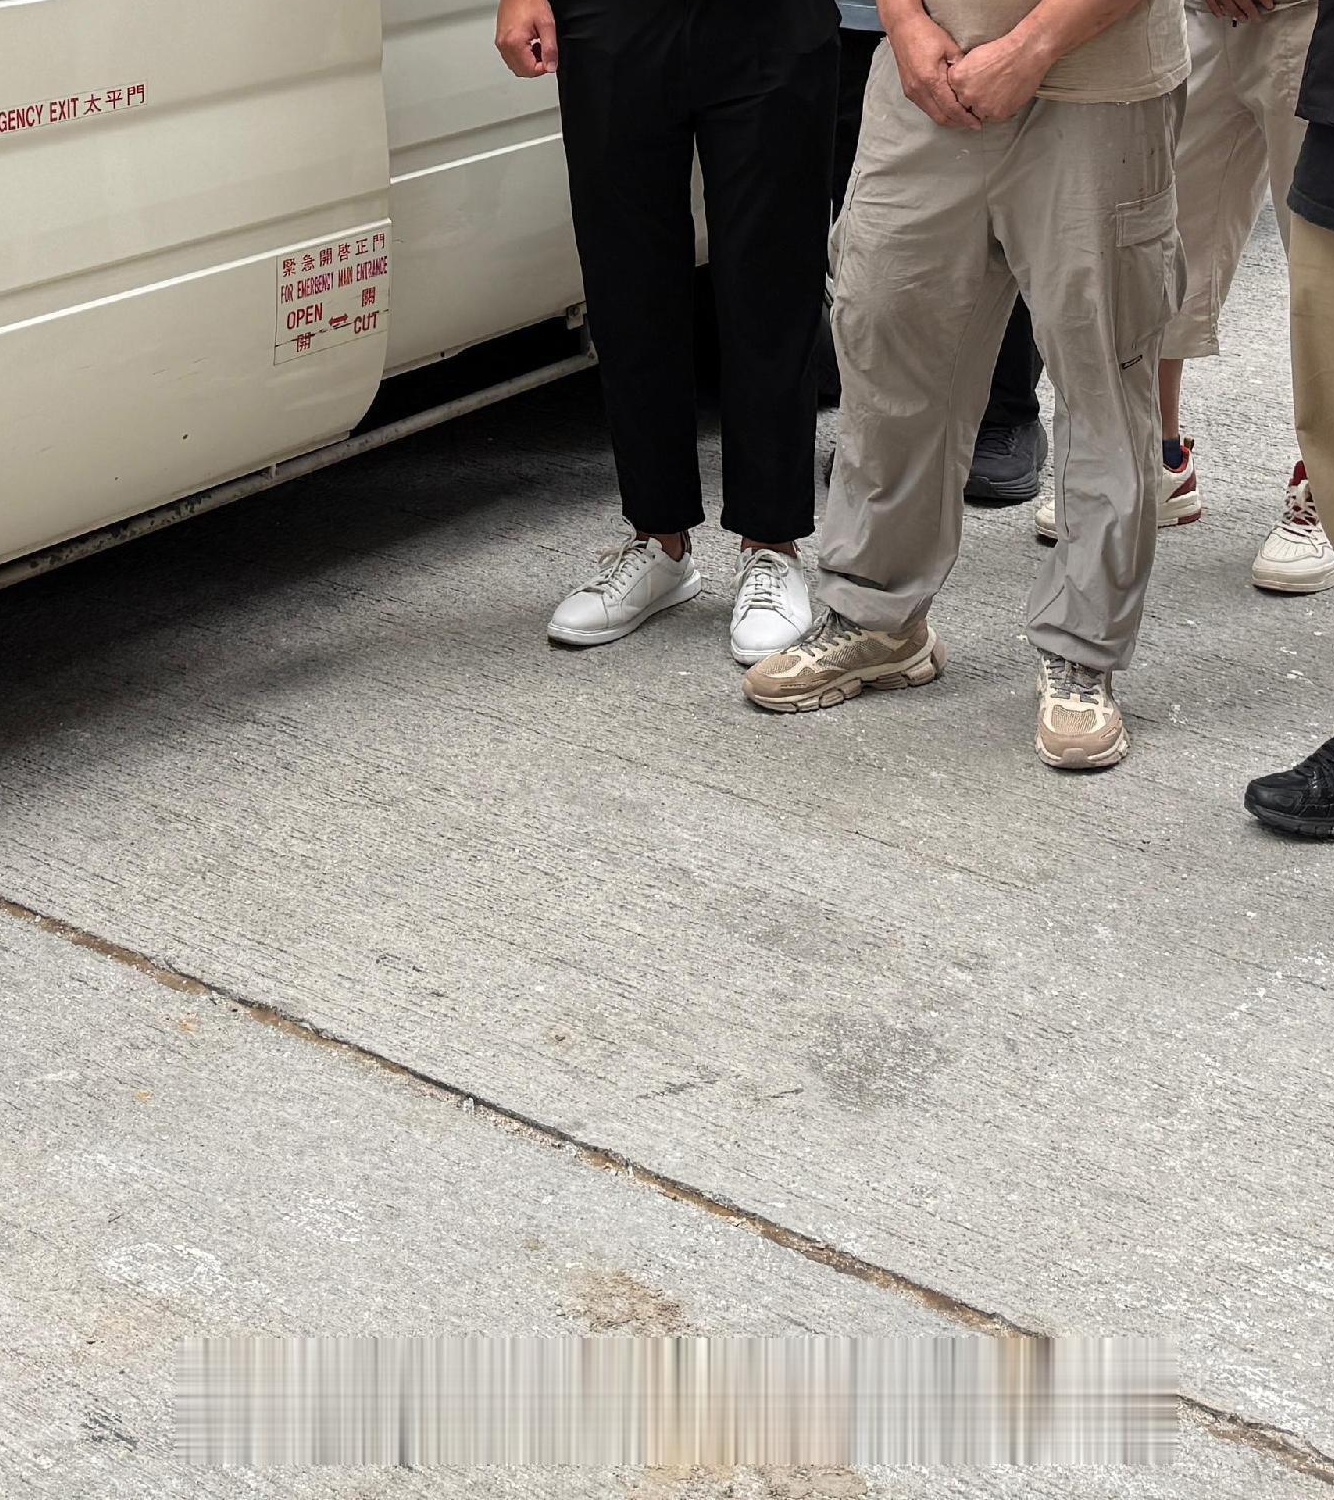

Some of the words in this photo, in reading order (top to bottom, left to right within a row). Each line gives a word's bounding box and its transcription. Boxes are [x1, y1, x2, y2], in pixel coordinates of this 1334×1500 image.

[49, 97, 80, 123] EXIT
[82, 83, 146, 116] 太平門
[280, 283, 295, 304] FOR
[296, 271, 335, 299] EMERGENCY
[337, 265, 354, 288] MAIN
[356, 255, 388, 282] ENTRANCE
[286, 302, 324, 330] OPEN
